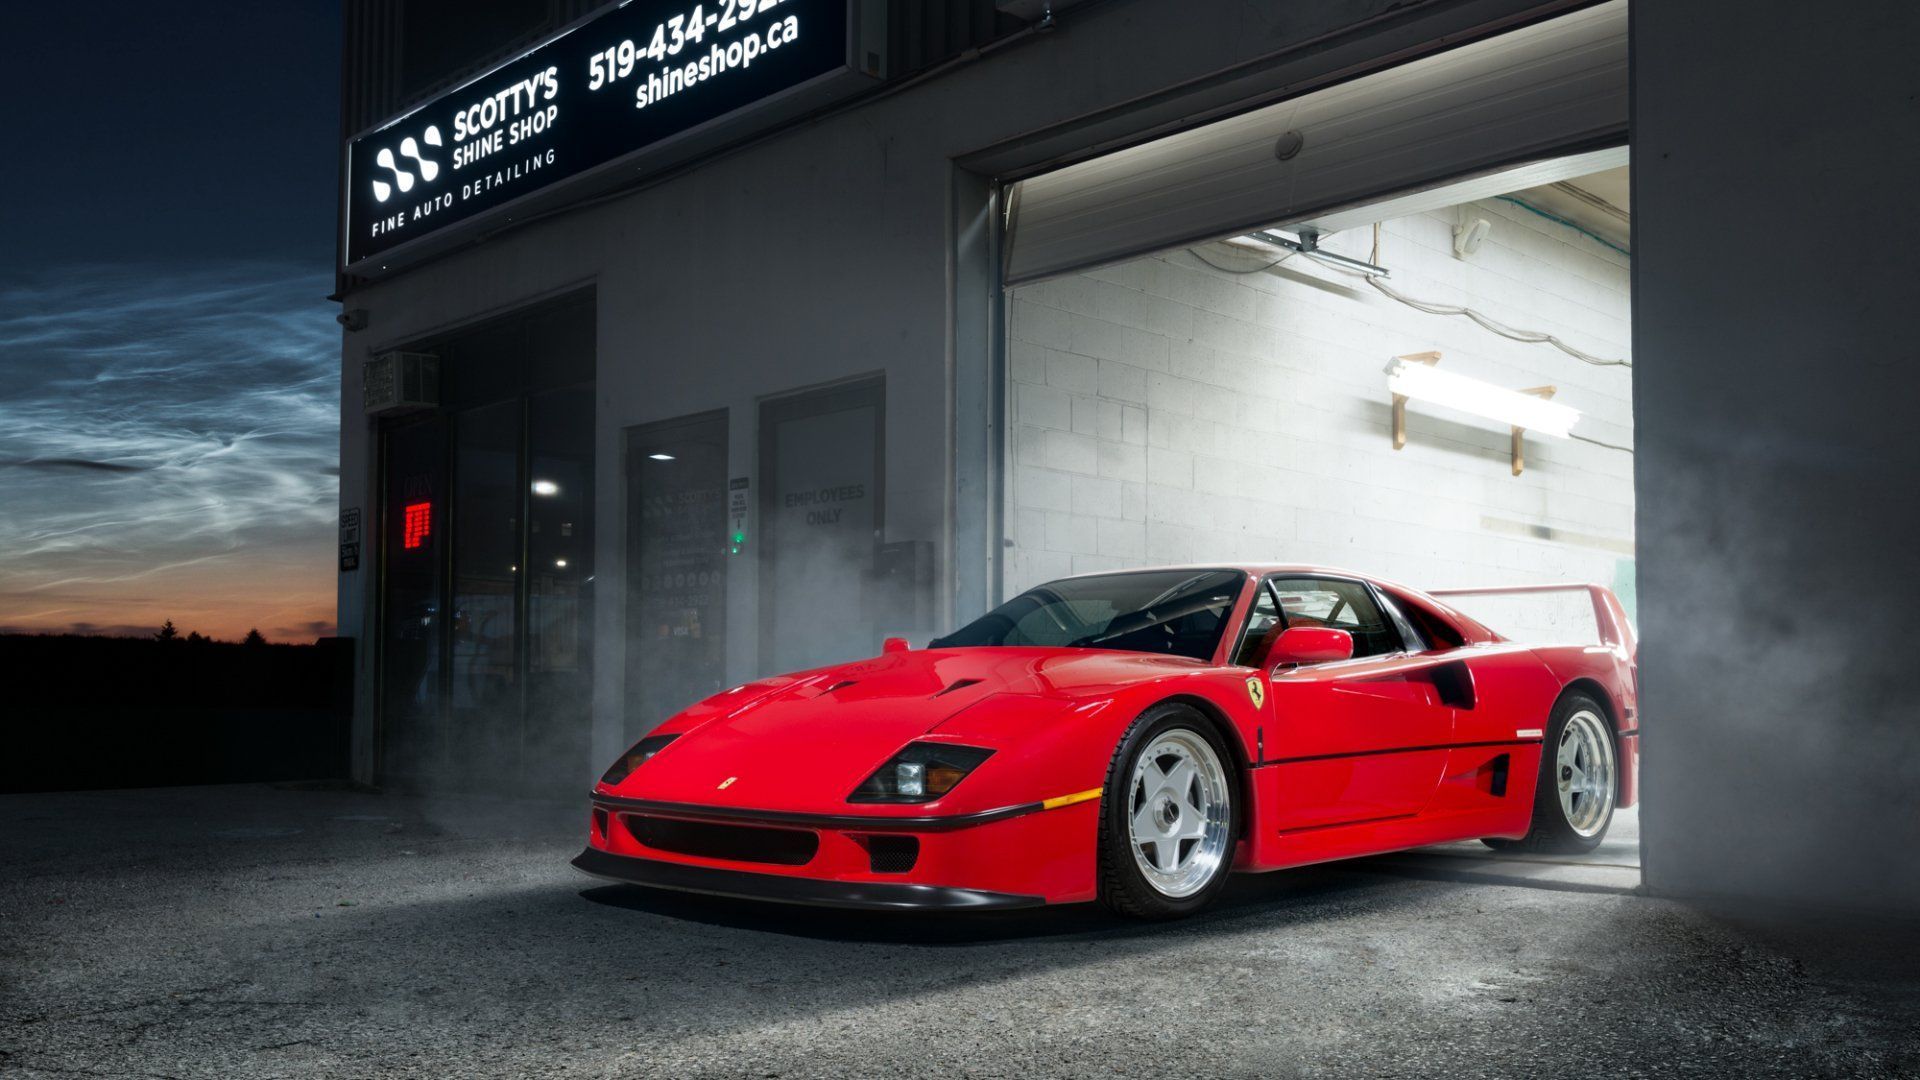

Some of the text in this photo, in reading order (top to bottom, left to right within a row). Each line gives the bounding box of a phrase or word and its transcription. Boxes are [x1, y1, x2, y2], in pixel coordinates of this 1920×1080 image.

[588, 0, 786, 91] 519-434-29
[635, 14, 799, 109] shineshop.ca
[453, 65, 559, 142] SCOTTY'S
[453, 104, 558, 170] SHINE SHOP
[372, 148, 556, 238] FINE AUTO DETAILING
[785, 484, 865, 508] EMPLOYEES
[806, 508, 843, 526] ONLY
